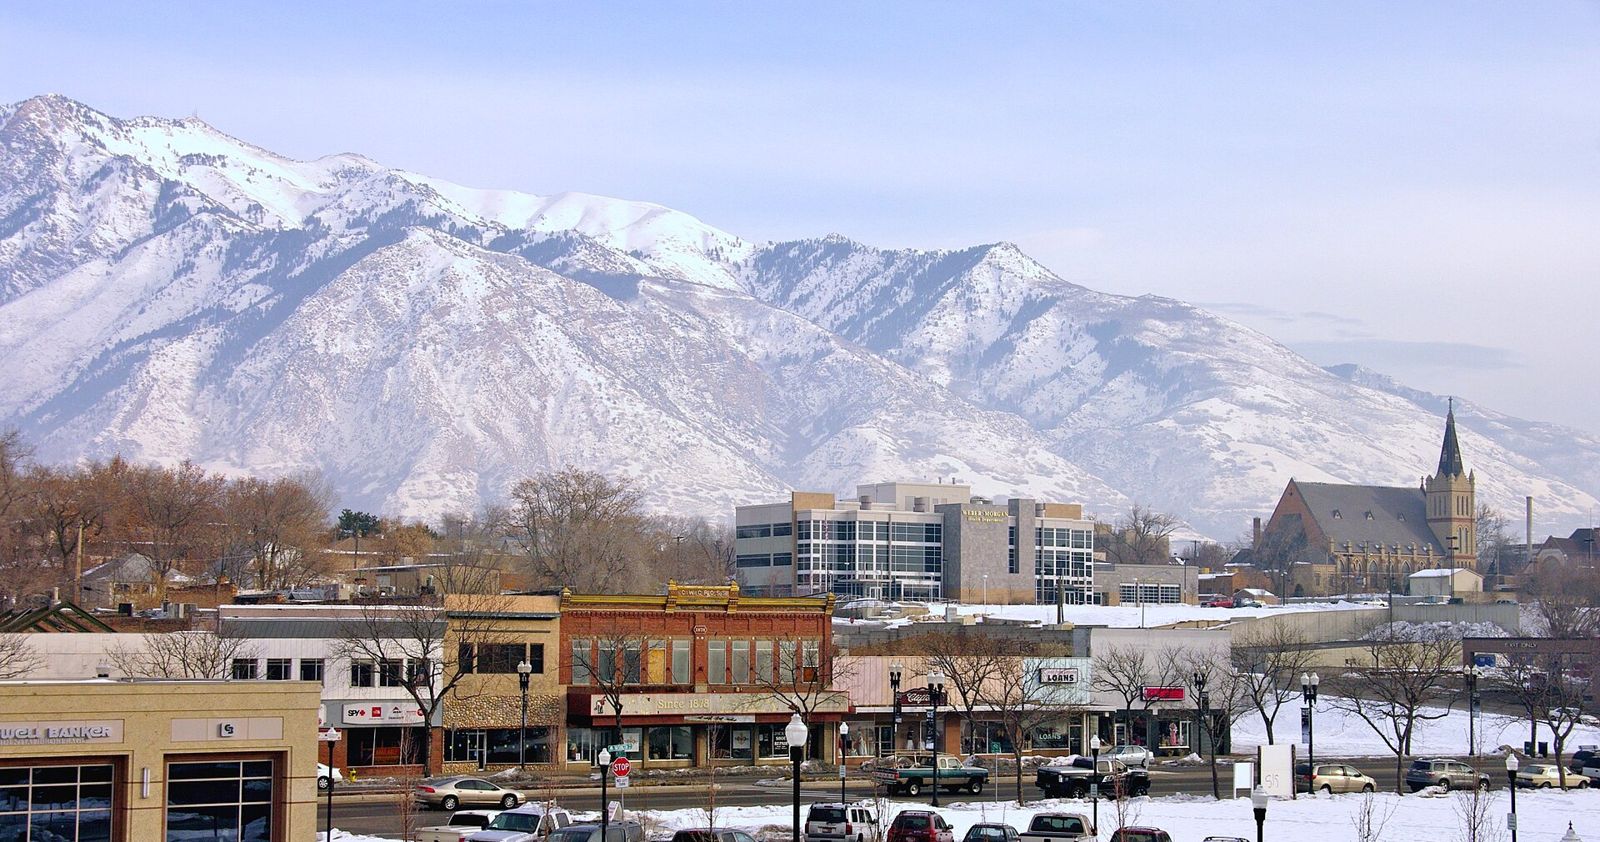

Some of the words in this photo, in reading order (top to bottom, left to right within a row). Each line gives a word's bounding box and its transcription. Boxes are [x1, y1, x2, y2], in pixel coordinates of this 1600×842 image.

[1047, 674, 1074, 682] LOANS
[657, 698, 684, 710] Since
[689, 698, 710, 710] 1878
[348, 709, 360, 717] SPY
[614, 763, 630, 772] STOP
